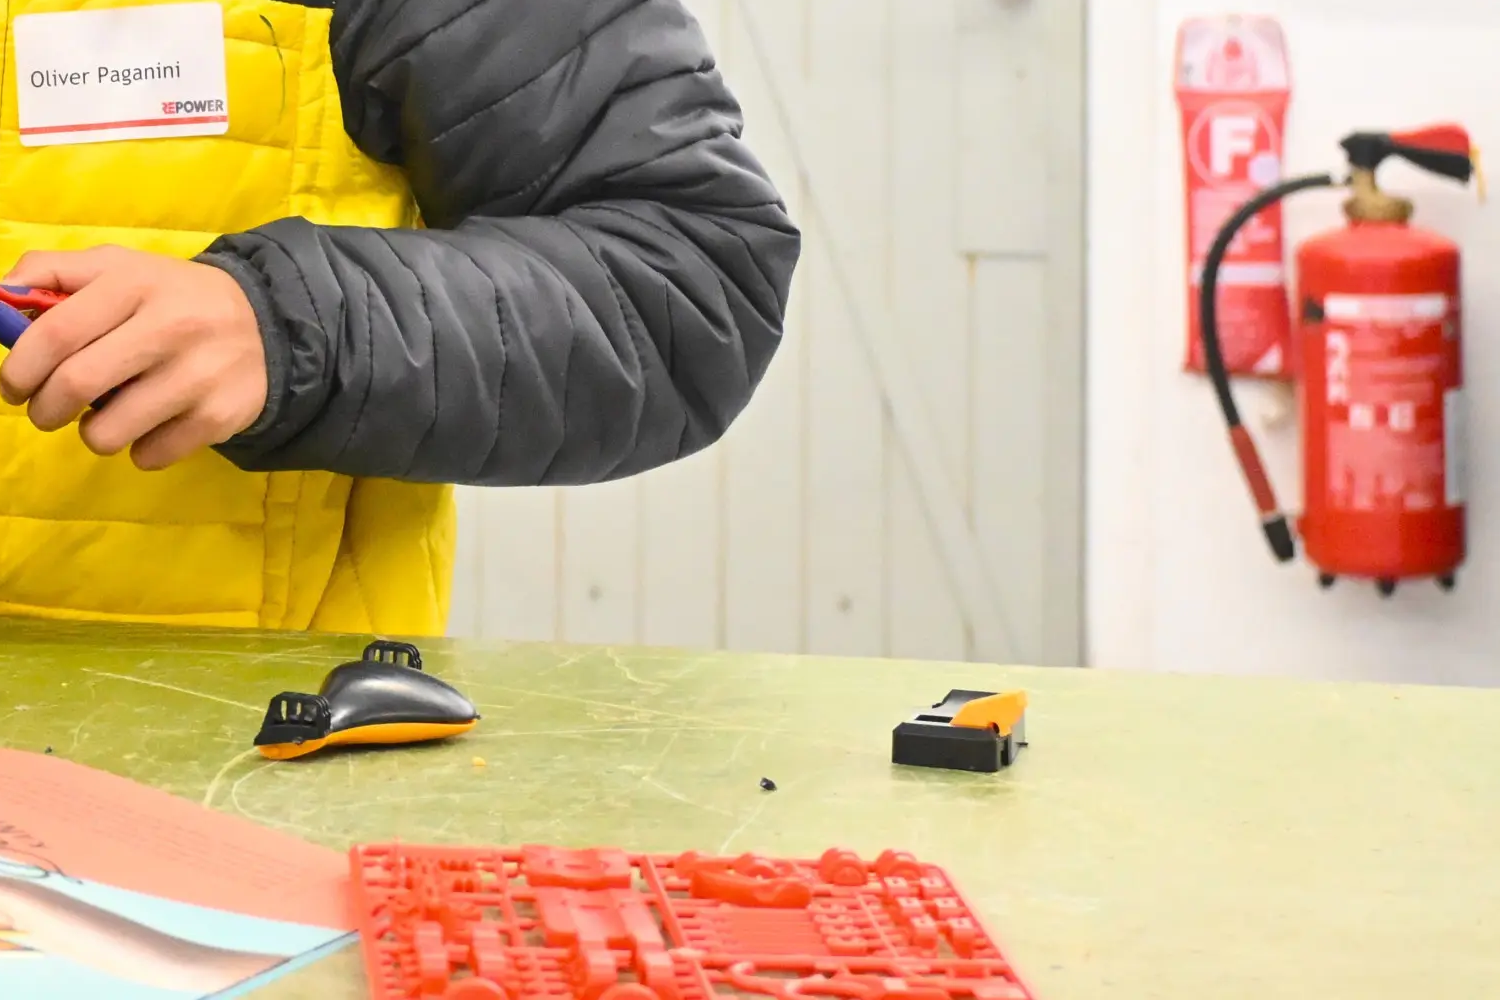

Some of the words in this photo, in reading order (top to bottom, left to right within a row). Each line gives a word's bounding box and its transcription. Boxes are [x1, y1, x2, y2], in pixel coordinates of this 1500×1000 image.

[30, 68, 89, 88] Oliver
[98, 61, 181, 86] Paganini
[162, 99, 224, 115] REPOWER
[1211, 117, 1255, 175] F
